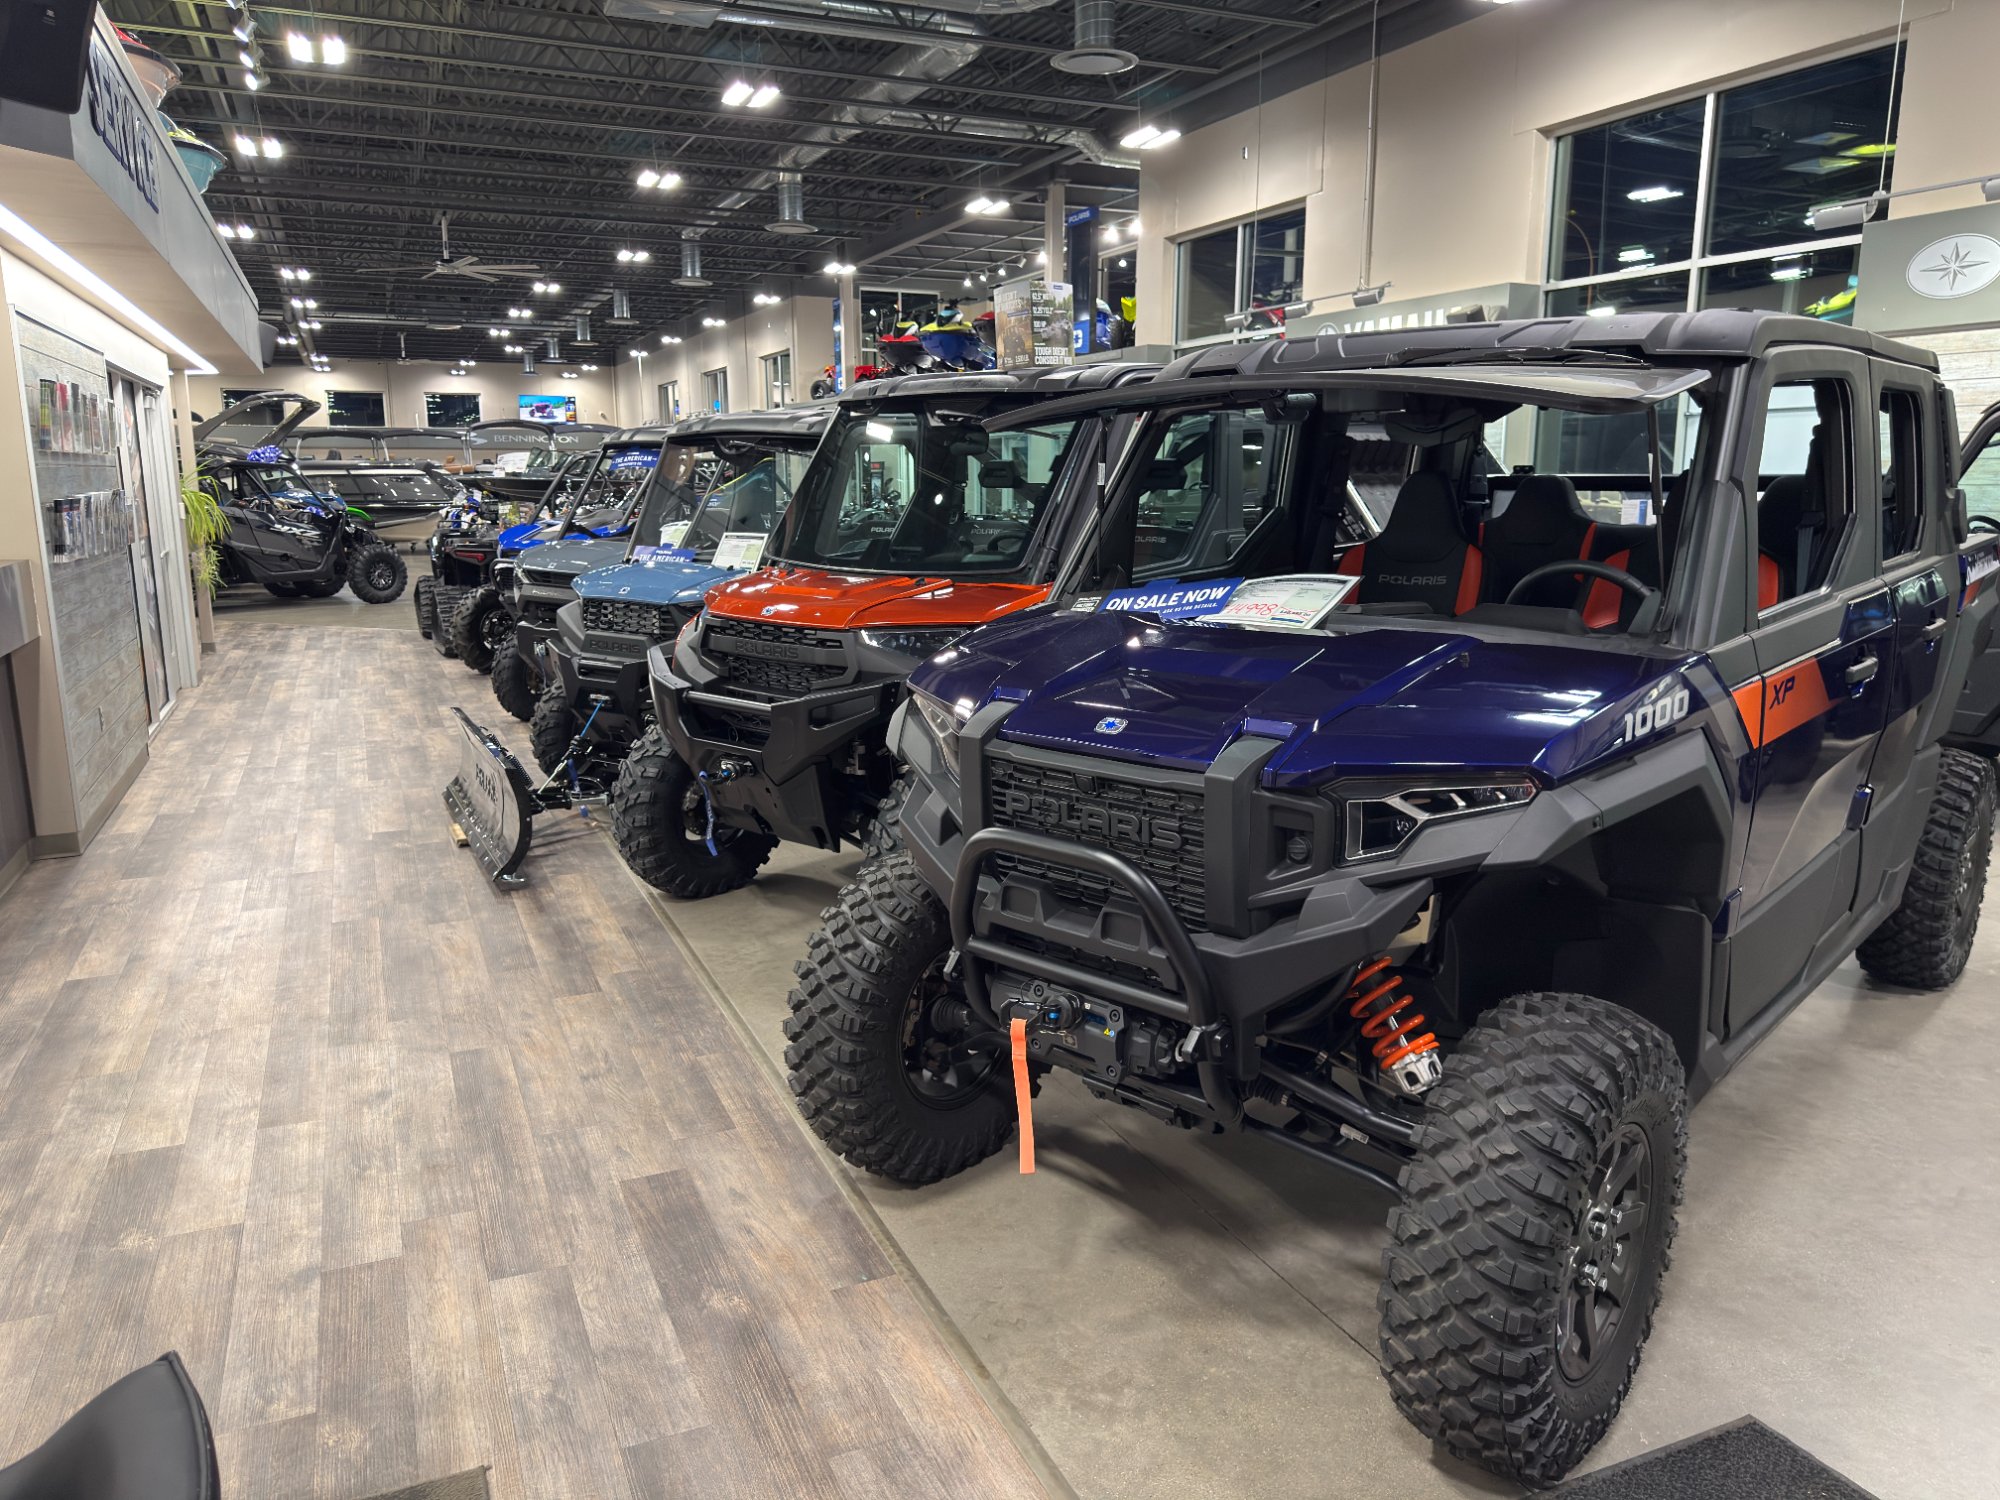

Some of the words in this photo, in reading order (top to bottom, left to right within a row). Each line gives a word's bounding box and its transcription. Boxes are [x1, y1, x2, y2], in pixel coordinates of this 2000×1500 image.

[88, 42, 160, 214] SERVICE
[1068, 210, 1090, 223] POLARIS
[1344, 306, 1463, 334] YAMAH
[1034, 347, 1052, 355] TOUGH
[1134, 536, 1167, 544] OLARIS
[640, 554, 651, 562] THE
[652, 554, 685, 562] AMERICAN
[1378, 574, 1447, 585] POLARIS
[1105, 597, 1134, 611] ON
[1133, 592, 1184, 609] SALE
[1183, 585, 1231, 603] NOW
[589, 639, 642, 654] POLARIS
[736, 639, 799, 659] POLARIS
[1769, 676, 1796, 710] XP
[1624, 688, 1690, 742] 1000
[1004, 790, 1183, 850] POLARIS
